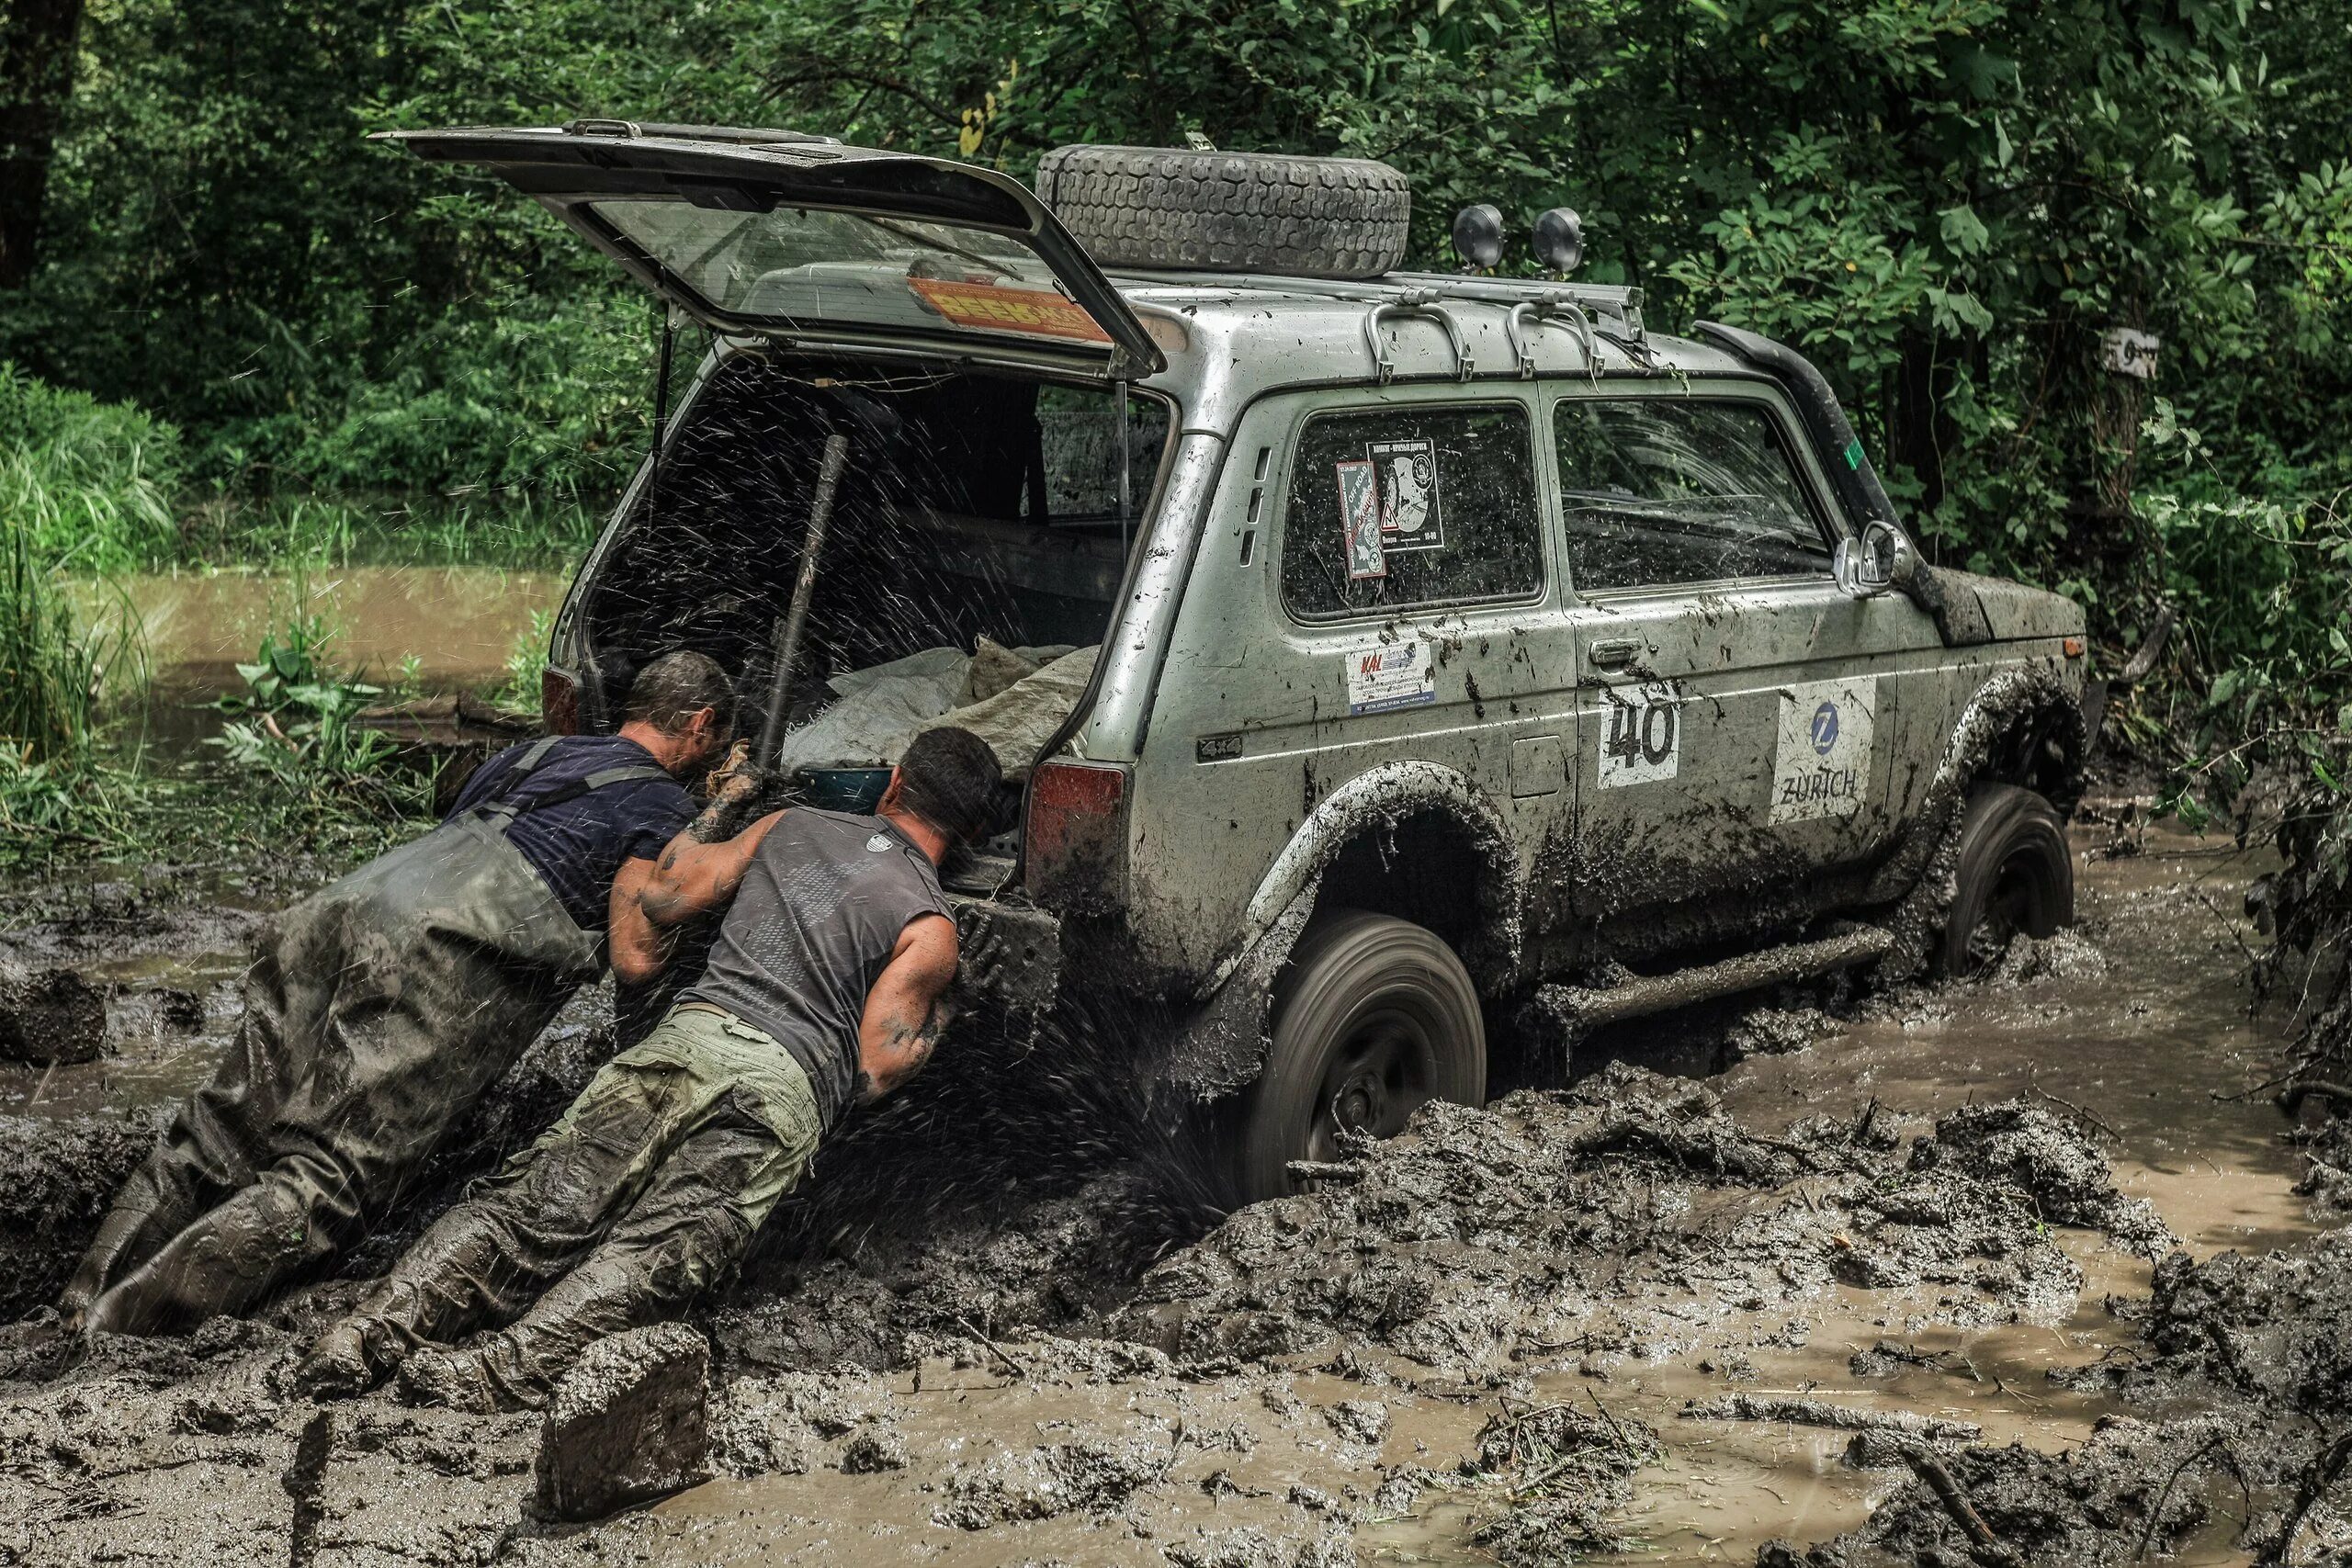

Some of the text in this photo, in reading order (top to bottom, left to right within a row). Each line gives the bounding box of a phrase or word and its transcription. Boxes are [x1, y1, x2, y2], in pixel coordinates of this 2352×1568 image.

[1348, 466, 1368, 503] OFF ROAD
[1607, 697, 1675, 769] 40
[1780, 769, 1858, 805] ZURICH
